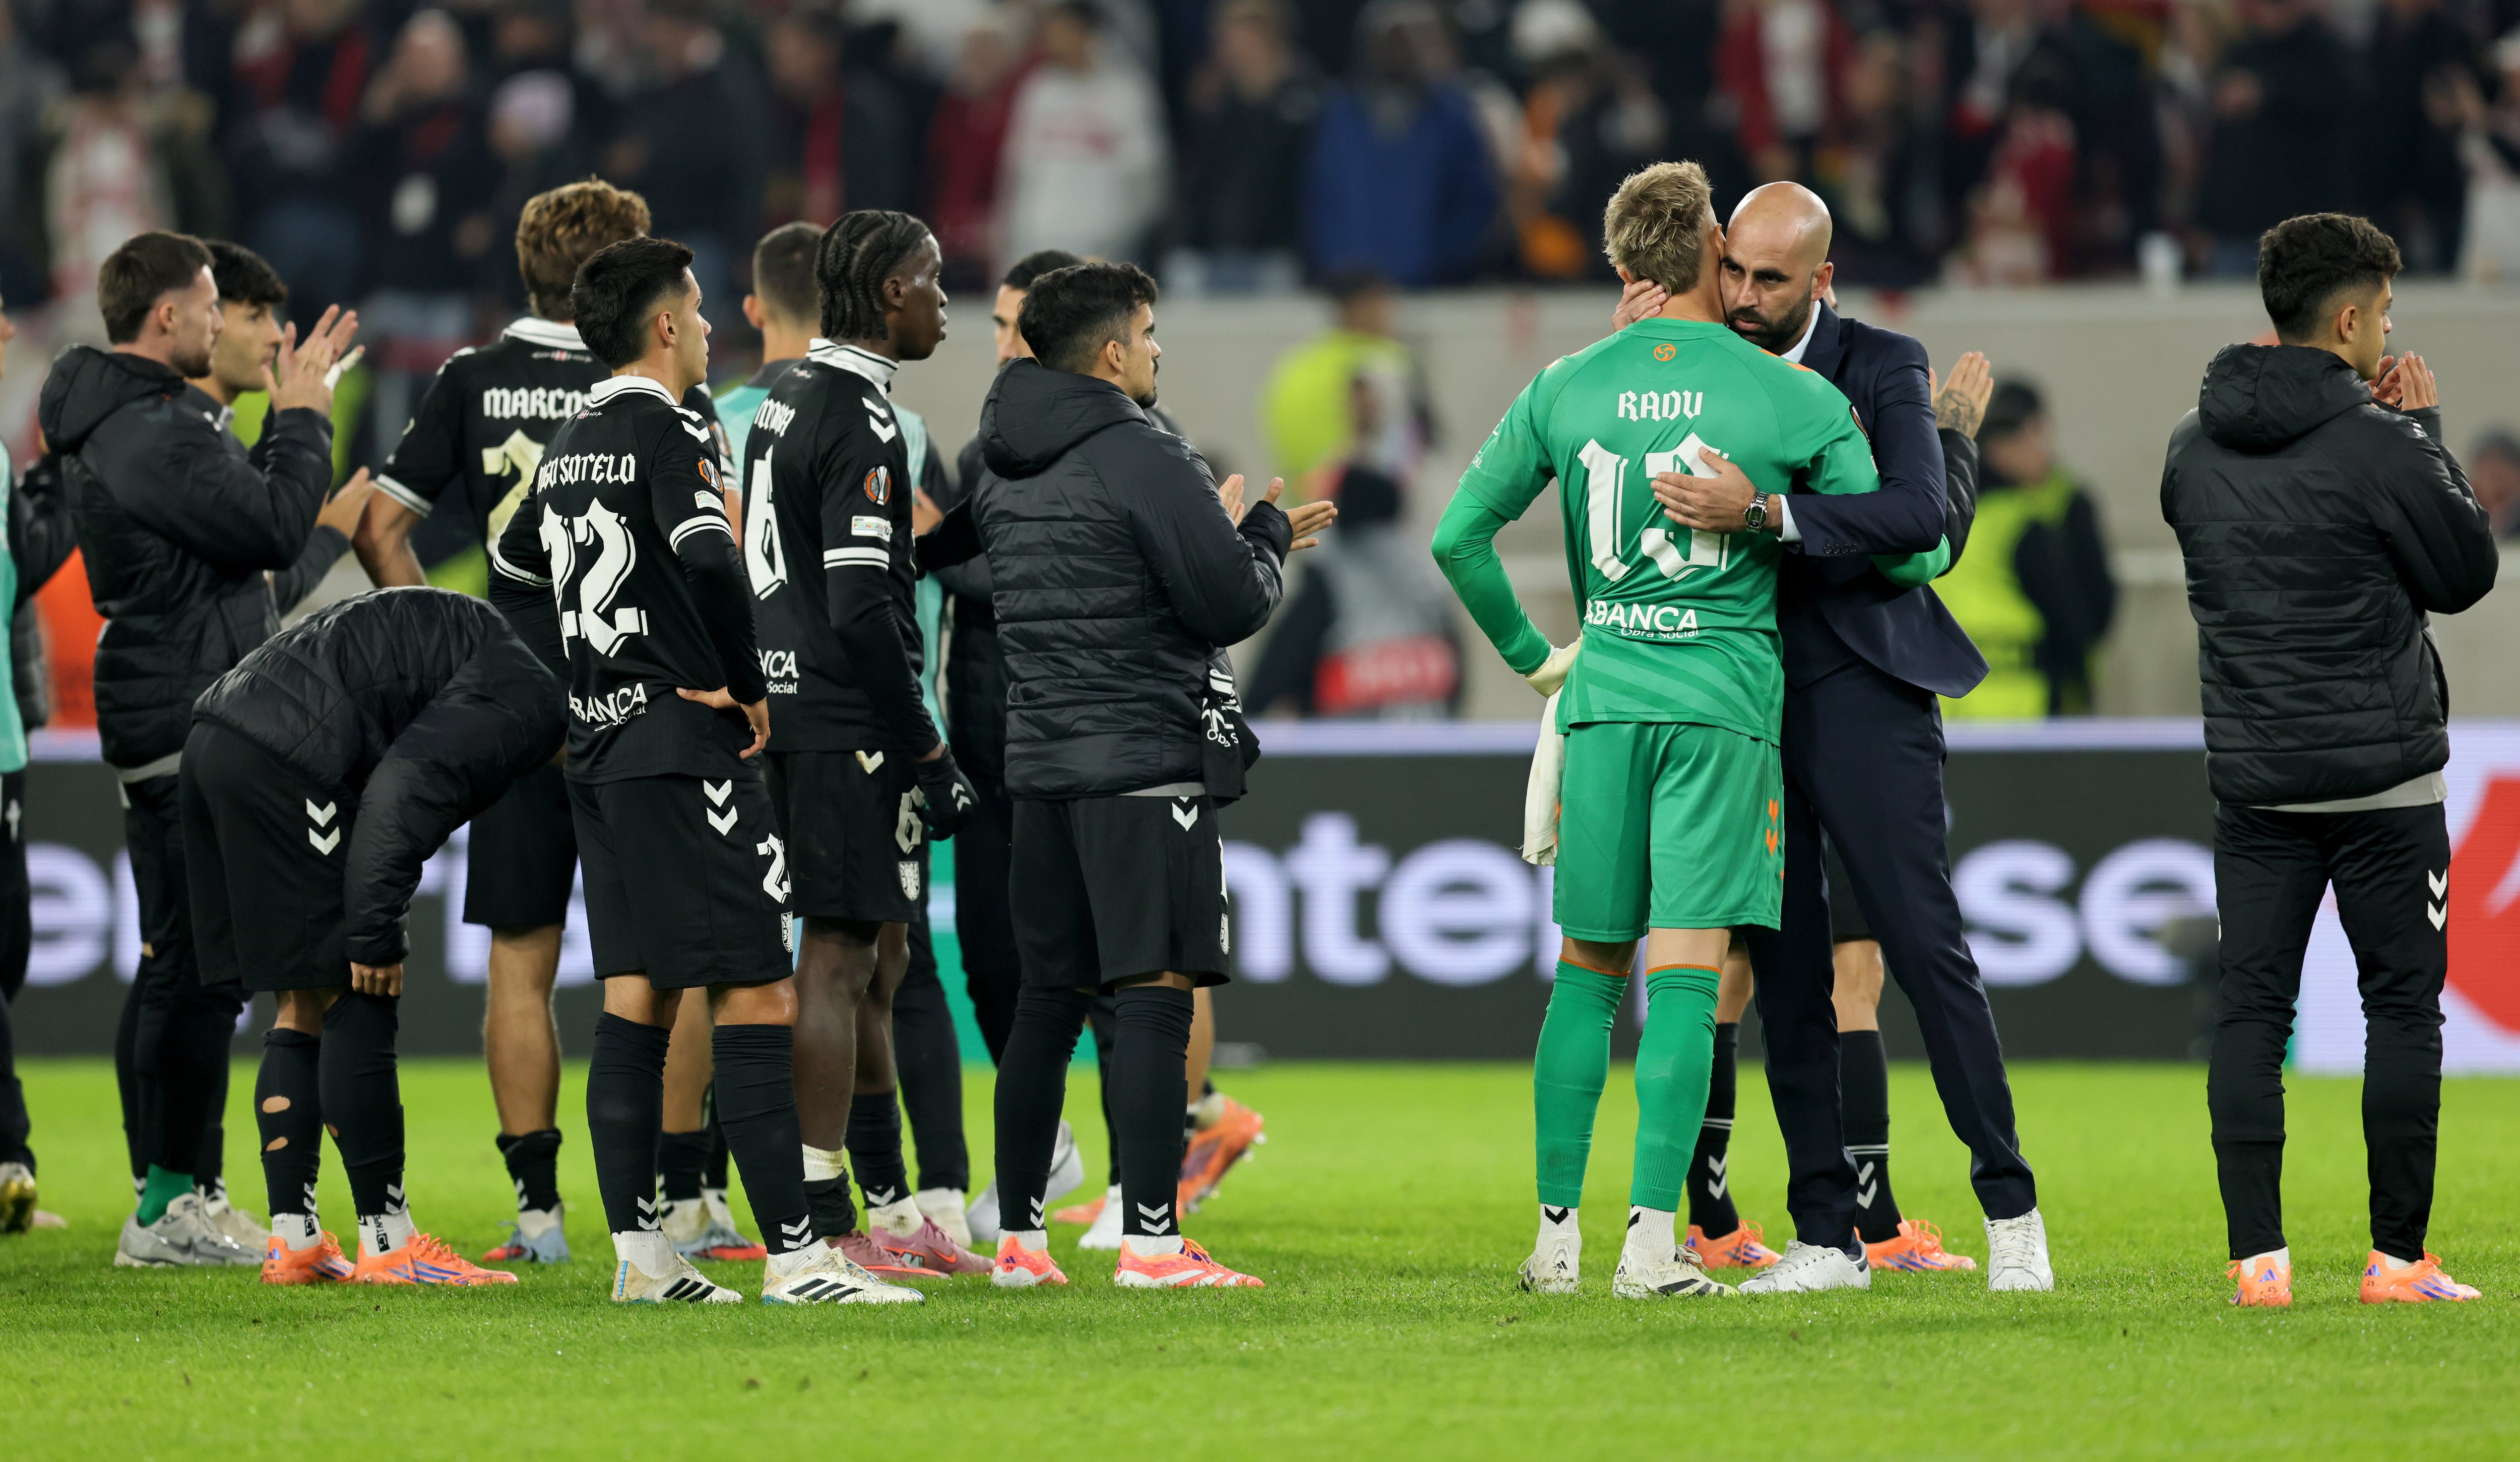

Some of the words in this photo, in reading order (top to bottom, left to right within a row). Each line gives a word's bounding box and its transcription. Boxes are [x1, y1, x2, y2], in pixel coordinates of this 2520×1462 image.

[1617, 390, 1704, 422] RADU
[537, 457, 559, 496] UGO
[559, 453, 636, 486] SOTELO
[742, 445, 788, 600] 6
[1577, 432, 1730, 582] 13
[538, 497, 649, 661] 22
[1584, 599, 1698, 632] ABANCA
[757, 647, 800, 678] NCA
[768, 681, 798, 694] Social
[895, 785, 924, 855] 6
